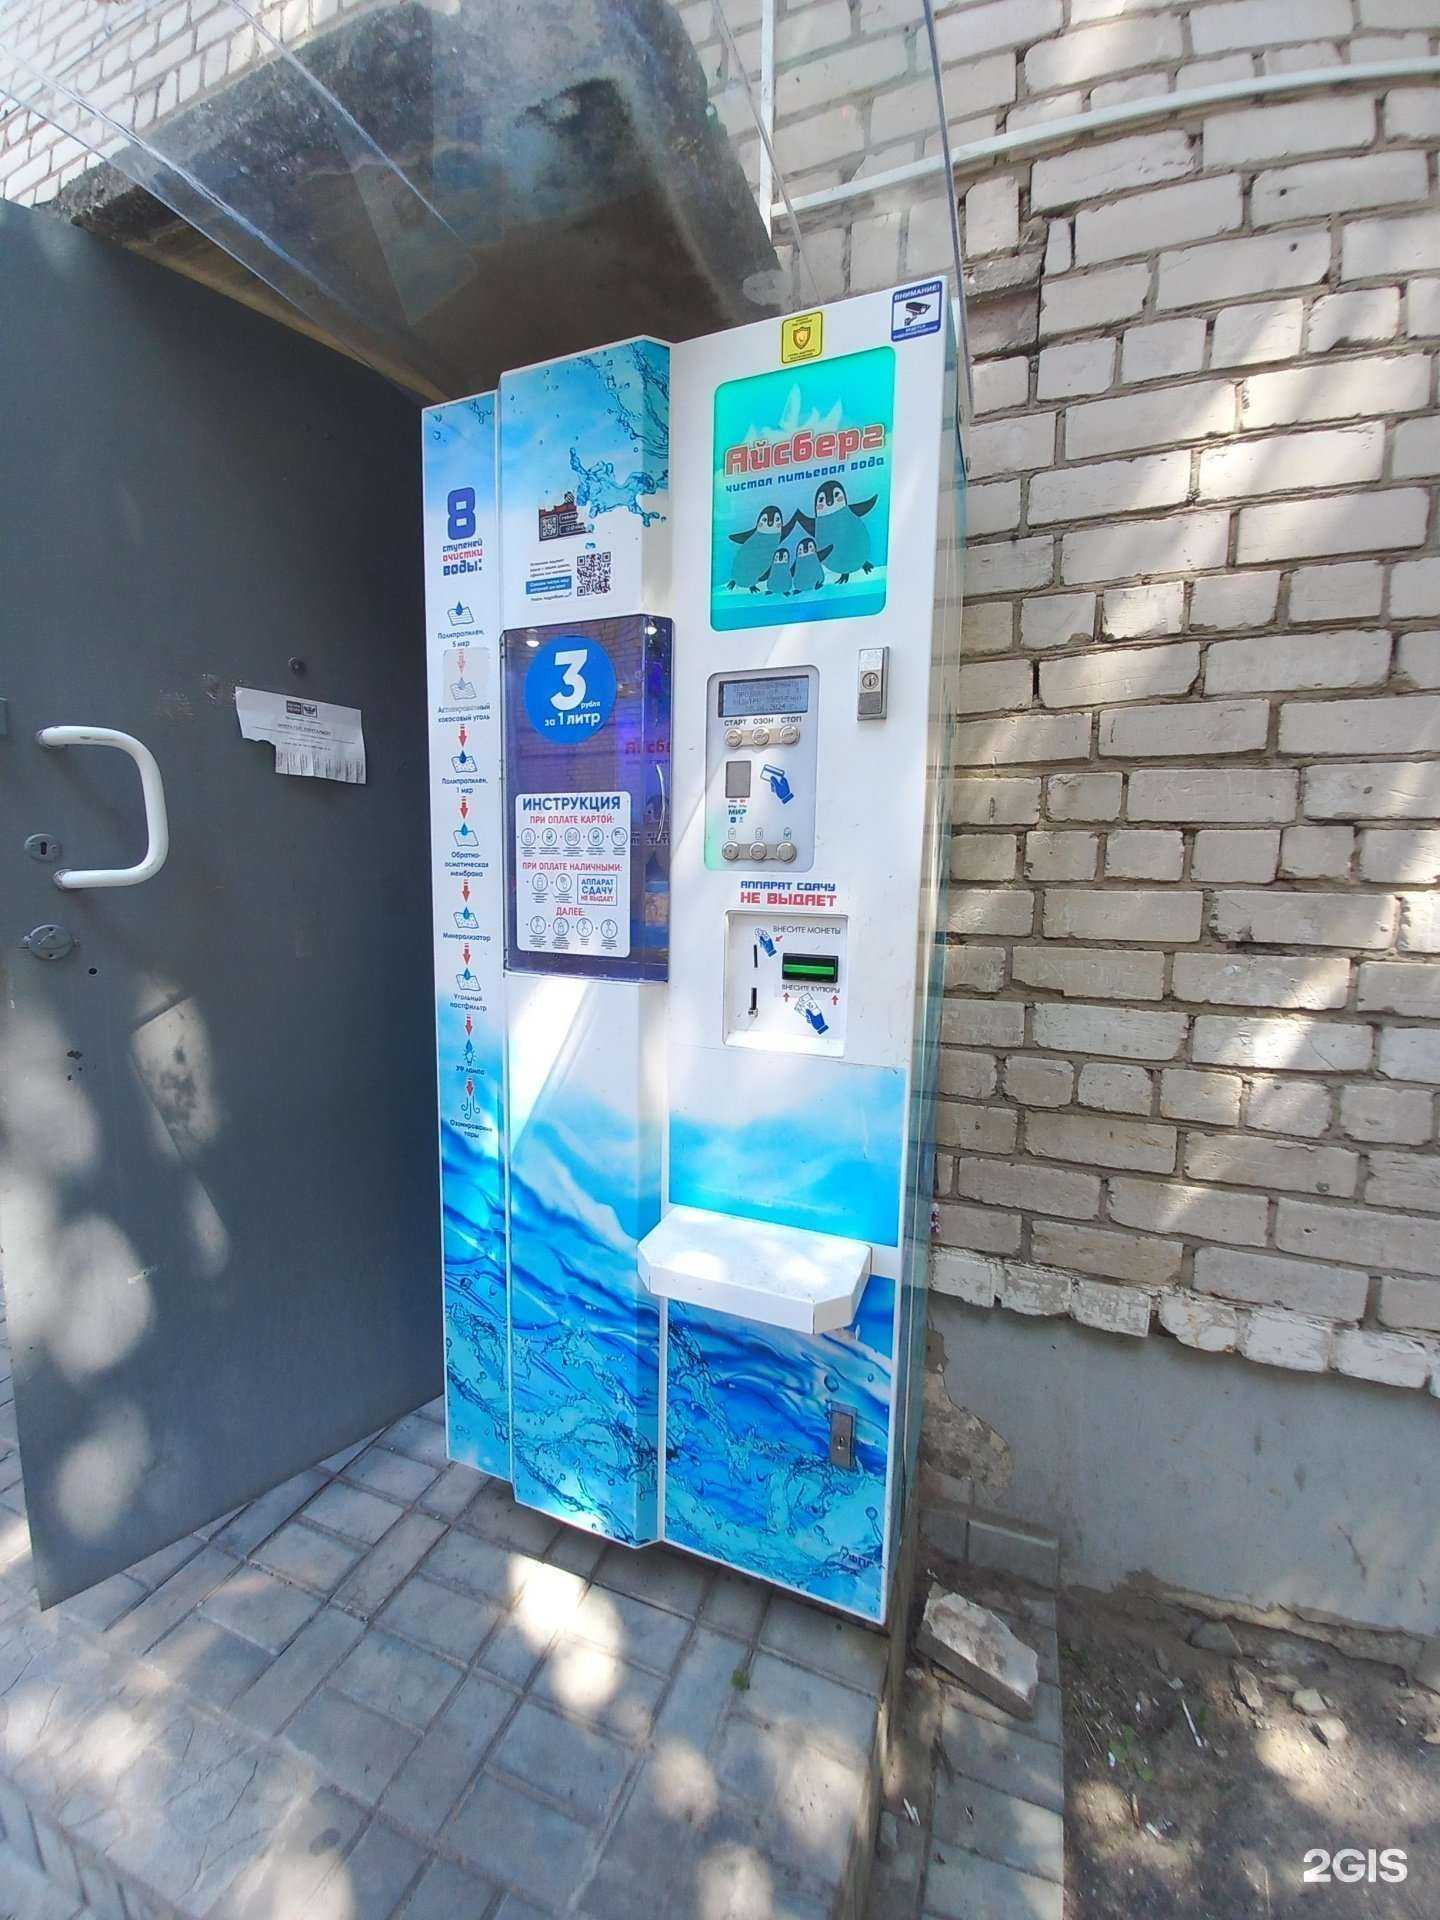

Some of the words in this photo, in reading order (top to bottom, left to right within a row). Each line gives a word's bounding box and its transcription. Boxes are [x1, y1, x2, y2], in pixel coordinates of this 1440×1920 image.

[894, 283, 941, 301] ВНИМАНИЕ!
[725, 423, 886, 477] Айсберг
[726, 478, 773, 492] чистая
[778, 464, 845, 484] питьевая
[850, 456, 884, 470] вода
[447, 487, 476, 540] 8
[442, 538, 483, 552] ступеней
[442, 549, 483, 562] очистки
[443, 559, 482, 576] воды:
[550, 648, 588, 711] 3
[580, 701, 601, 710] рубля
[544, 719, 556, 727] за
[558, 711, 564, 726] 1
[566, 712, 601, 727] литр
[724, 719, 747, 727] СТАРТ
[753, 717, 774, 725] ОЗОН
[780, 716, 802, 724] СТОП
[522, 795, 621, 812] ИНСТРУКЦИЯ
[529, 815, 546, 824] ПРИ
[547, 815, 578, 824] ОПЛАТЕ
[580, 813, 615, 824] КАРТОЙ:
[728, 808, 747, 816] МИР
[522, 862, 537, 870] ПРИ
[539, 862, 568, 871] ОПЛАТЕ
[569, 862, 623, 872] НАЛИЧНЫМИ:
[581, 878, 614, 886] АППАРАТ
[740, 880, 793, 891] АППАРАТ
[796, 882, 836, 892] СДАЧУ
[581, 886, 613, 895] СДАЧУ
[740, 892, 761, 904] НЕ
[766, 892, 837, 907] ВЫДАЕТ
[772, 925, 807, 934] ВНЕСИТЕ
[807, 926, 841, 935] МОНЕТЫ
[782, 983, 809, 992] ВНЕСИТЕ
[810, 985, 841, 994] КУПЮРЫ
